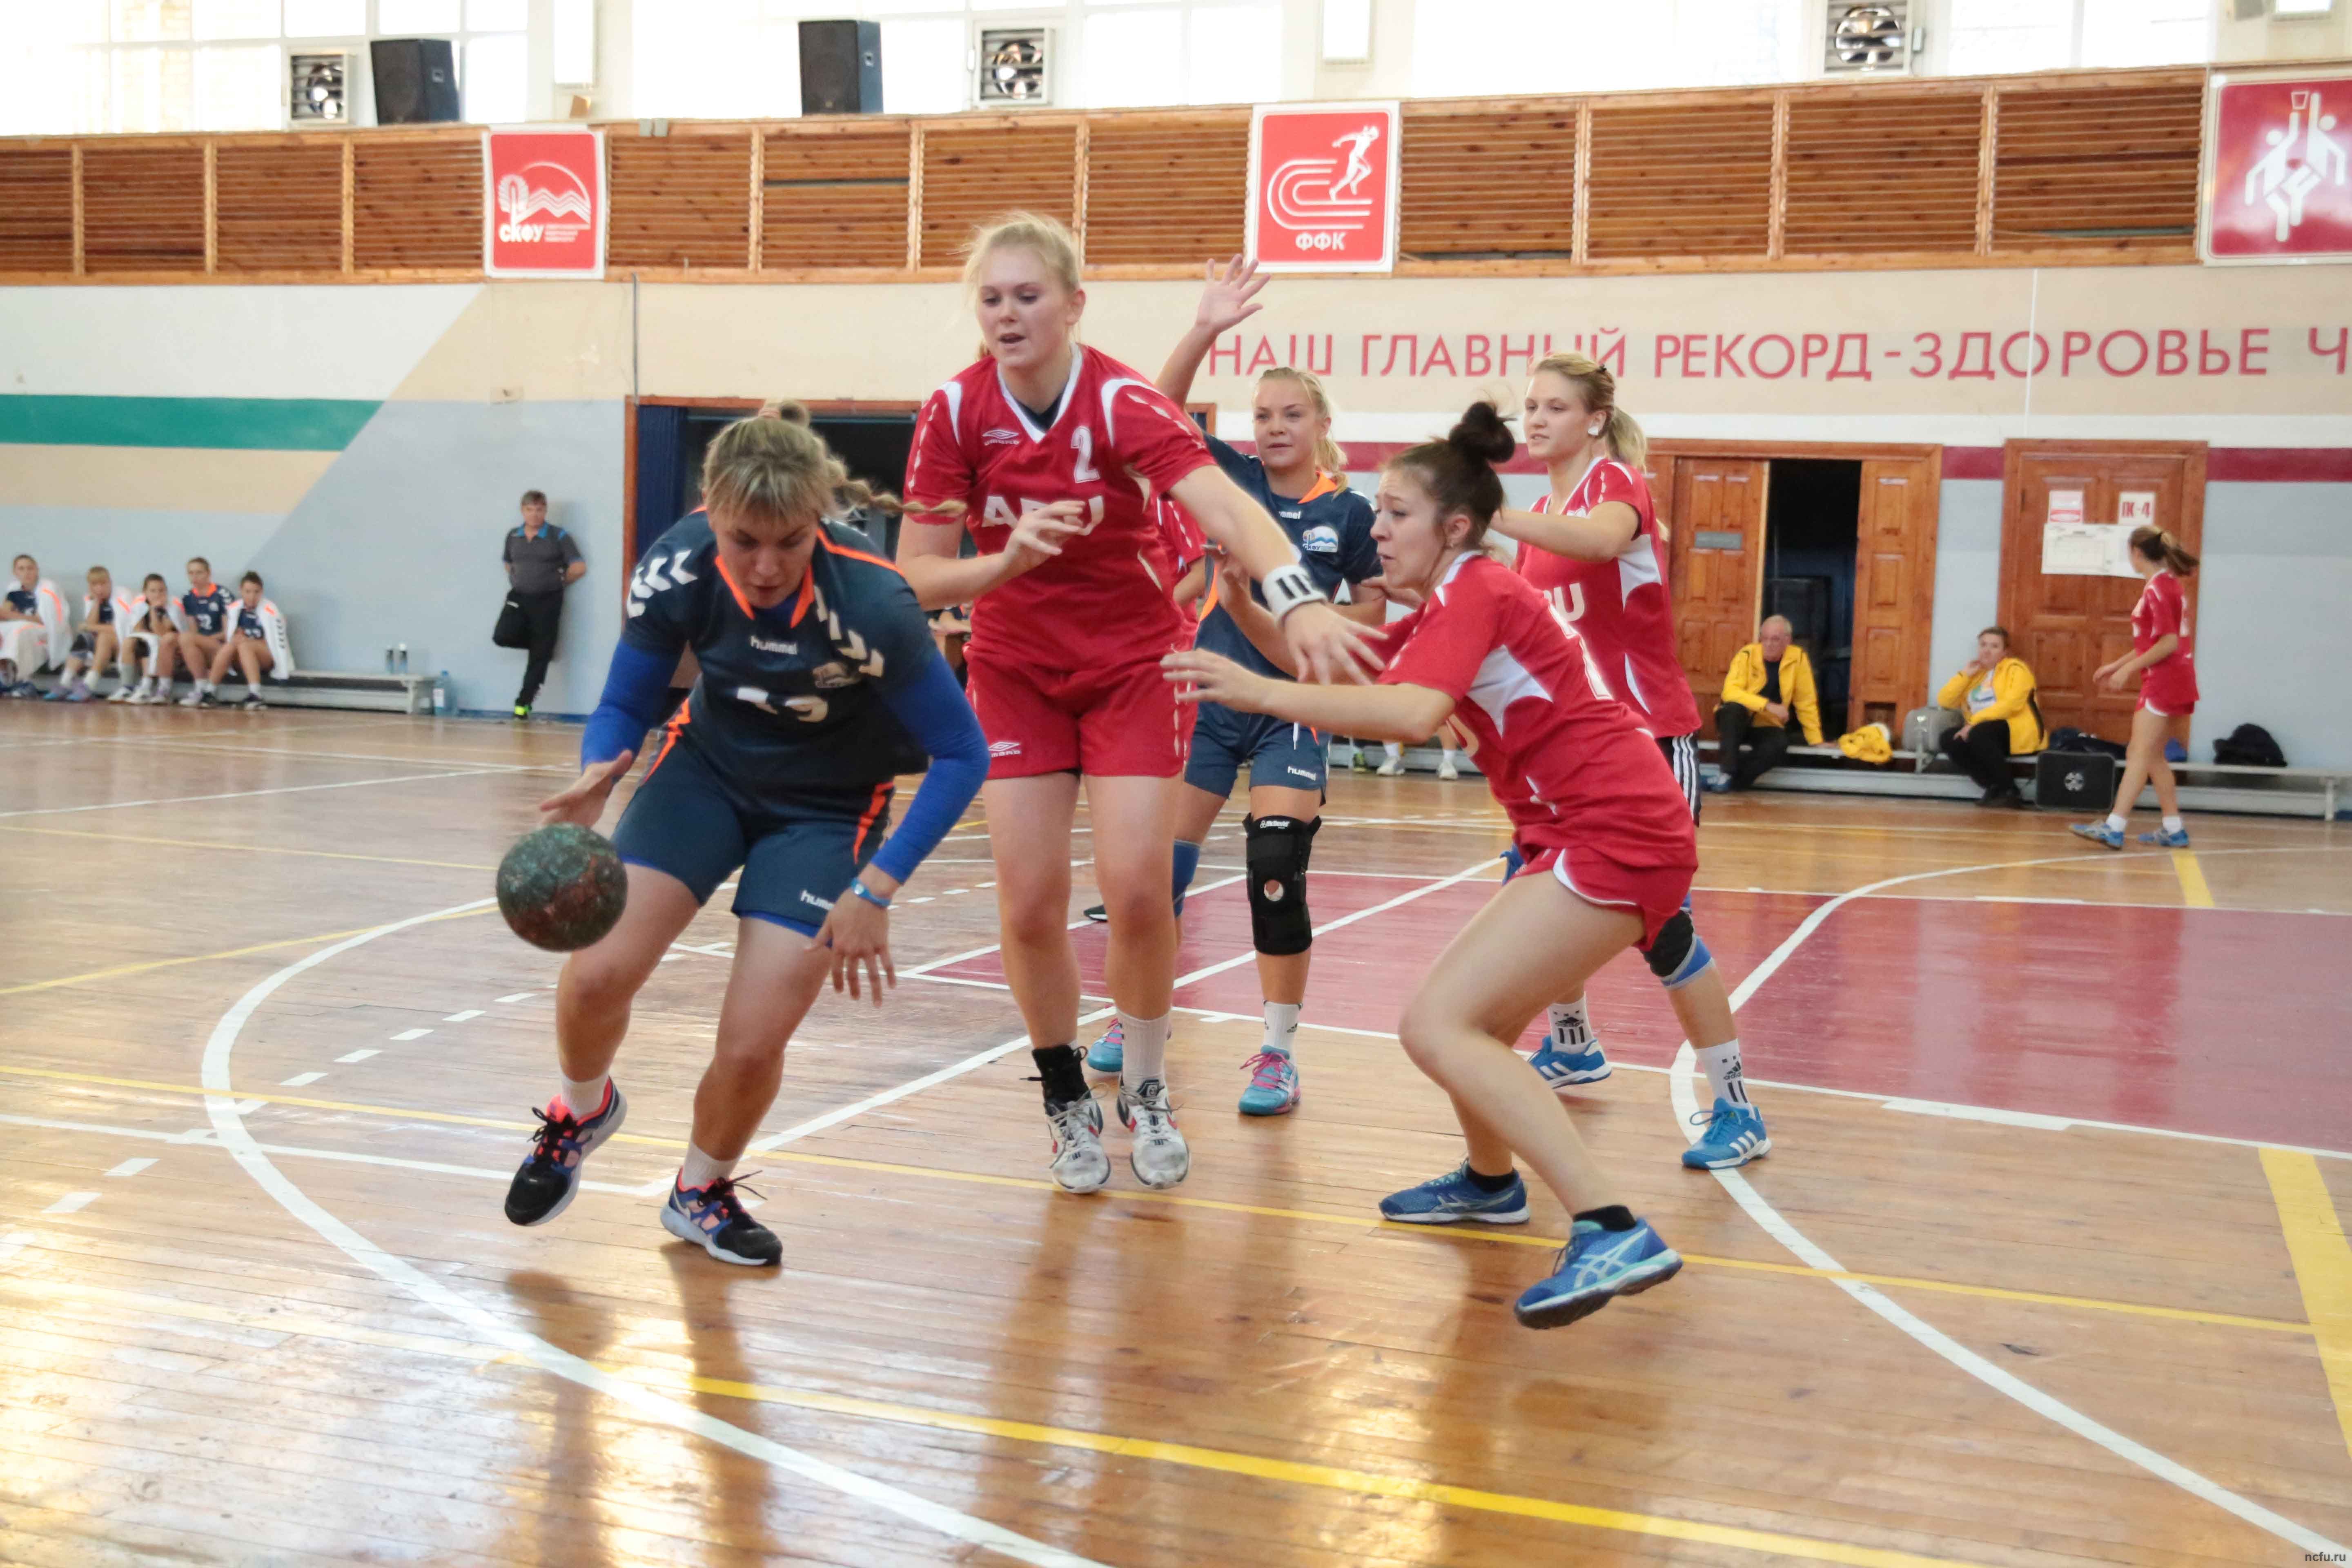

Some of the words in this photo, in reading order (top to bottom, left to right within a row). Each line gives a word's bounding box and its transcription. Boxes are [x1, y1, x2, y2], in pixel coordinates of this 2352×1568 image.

[1295, 232, 1346, 251] ФФК
[1209, 334, 1333, 376] НАШ
[1071, 426, 1101, 483] 2
[750, 635, 797, 655] hummel
[1287, 766, 1316, 781] hummel
